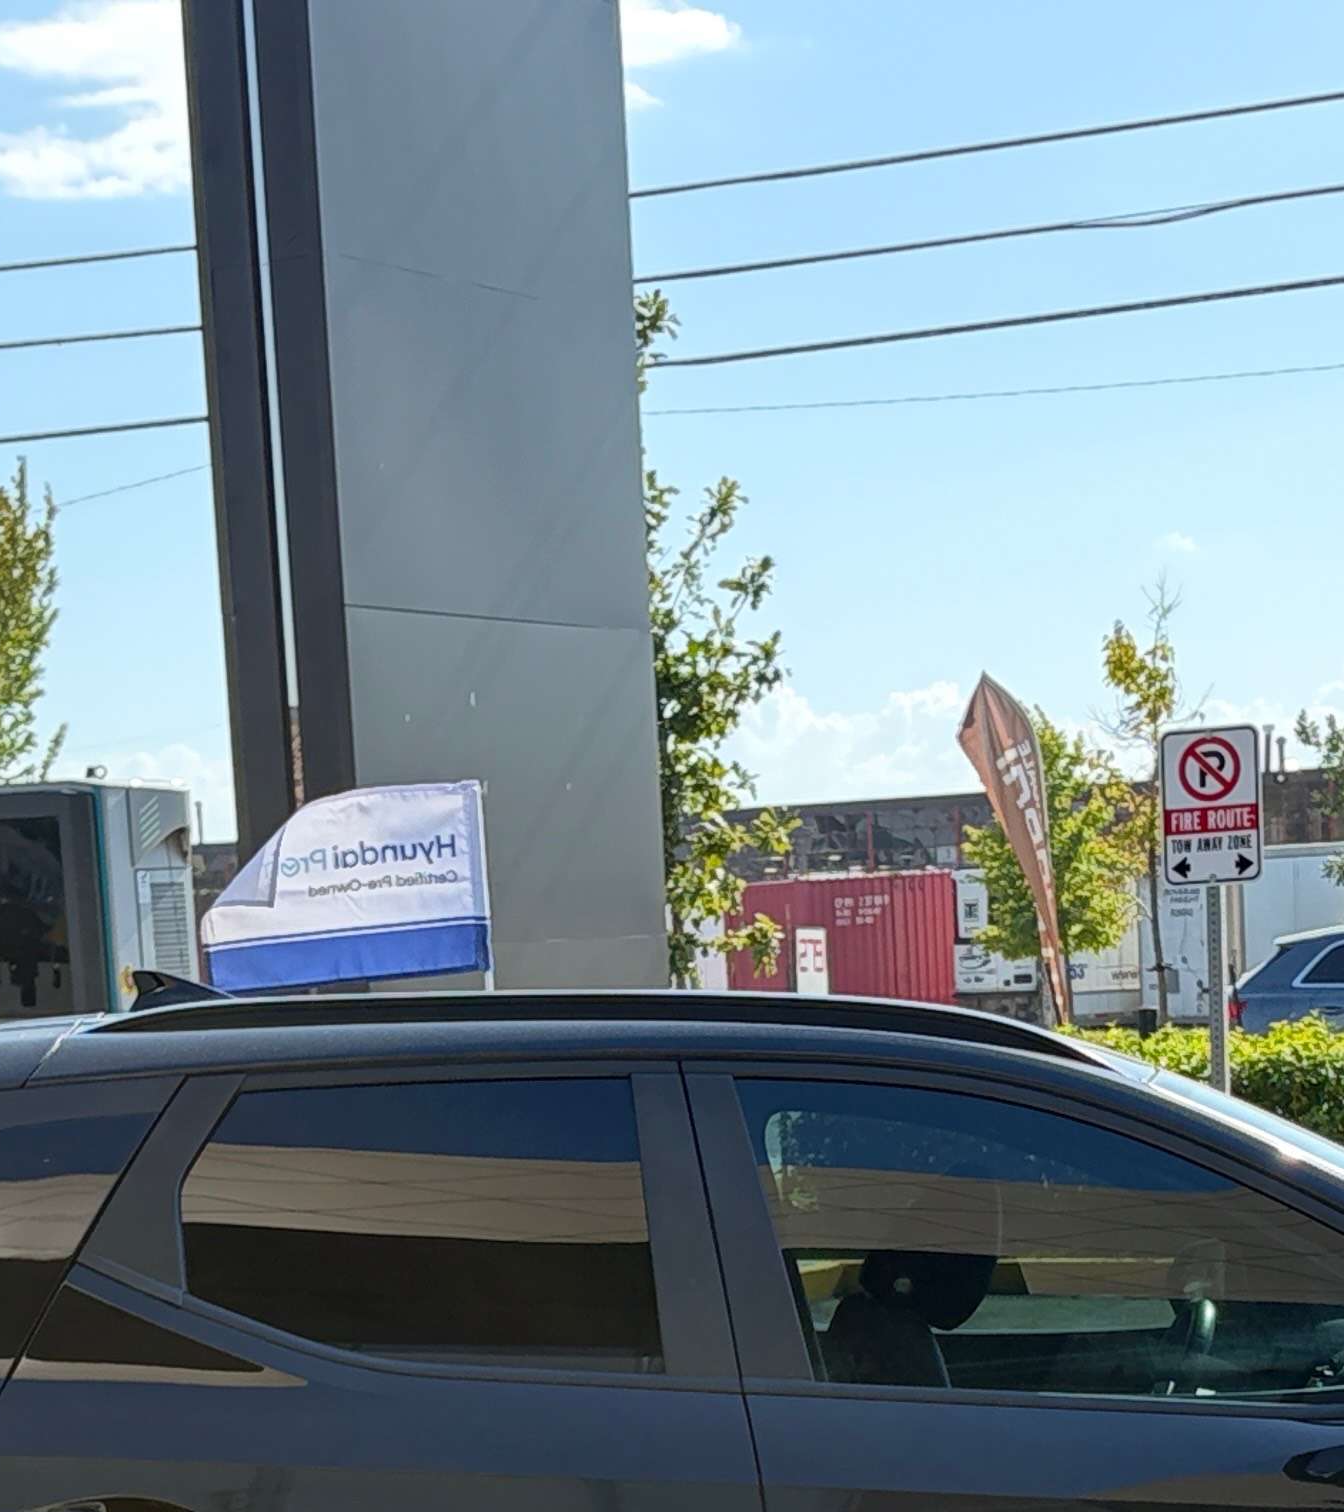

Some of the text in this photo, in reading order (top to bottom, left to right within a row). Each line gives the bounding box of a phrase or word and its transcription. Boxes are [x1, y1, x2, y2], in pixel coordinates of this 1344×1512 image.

[1170, 807, 1252, 833] FIRE ROUTE
[1171, 834, 1253, 854] TOW AWAY ZONE
